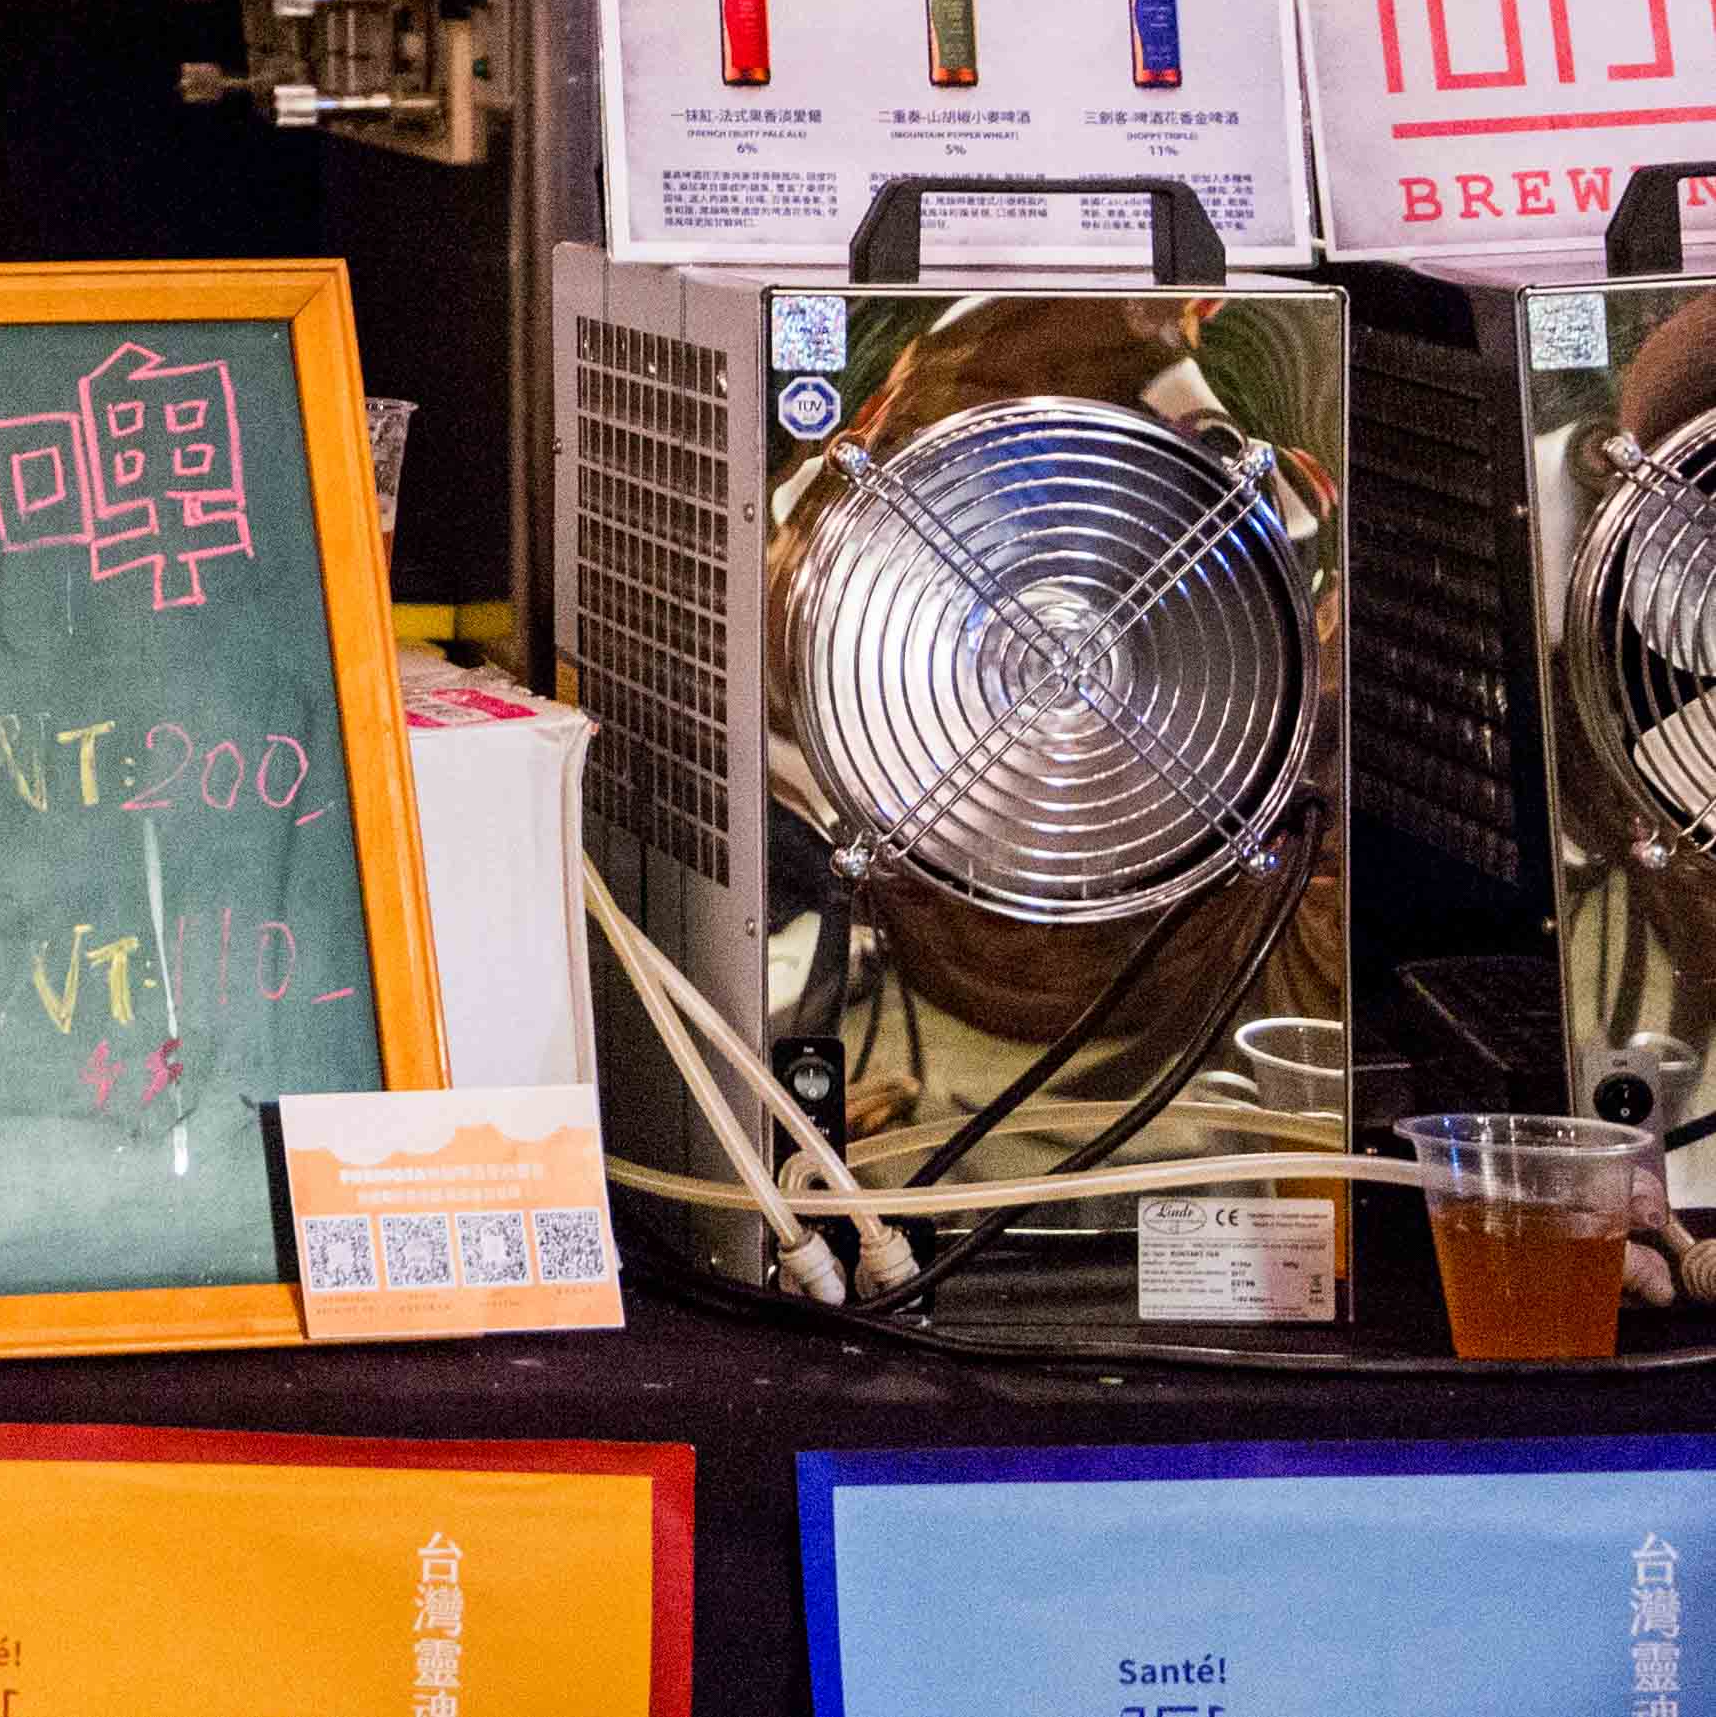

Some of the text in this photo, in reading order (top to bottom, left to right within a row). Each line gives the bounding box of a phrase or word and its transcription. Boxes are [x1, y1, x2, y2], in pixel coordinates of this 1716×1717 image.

[736, 143, 758, 154] 6%
[945, 144, 967, 155] 5%
[1148, 145, 1179, 156] 11%
[1399, 164, 1716, 223] BREWN
[1118, 1652, 1227, 1685] Santé!
